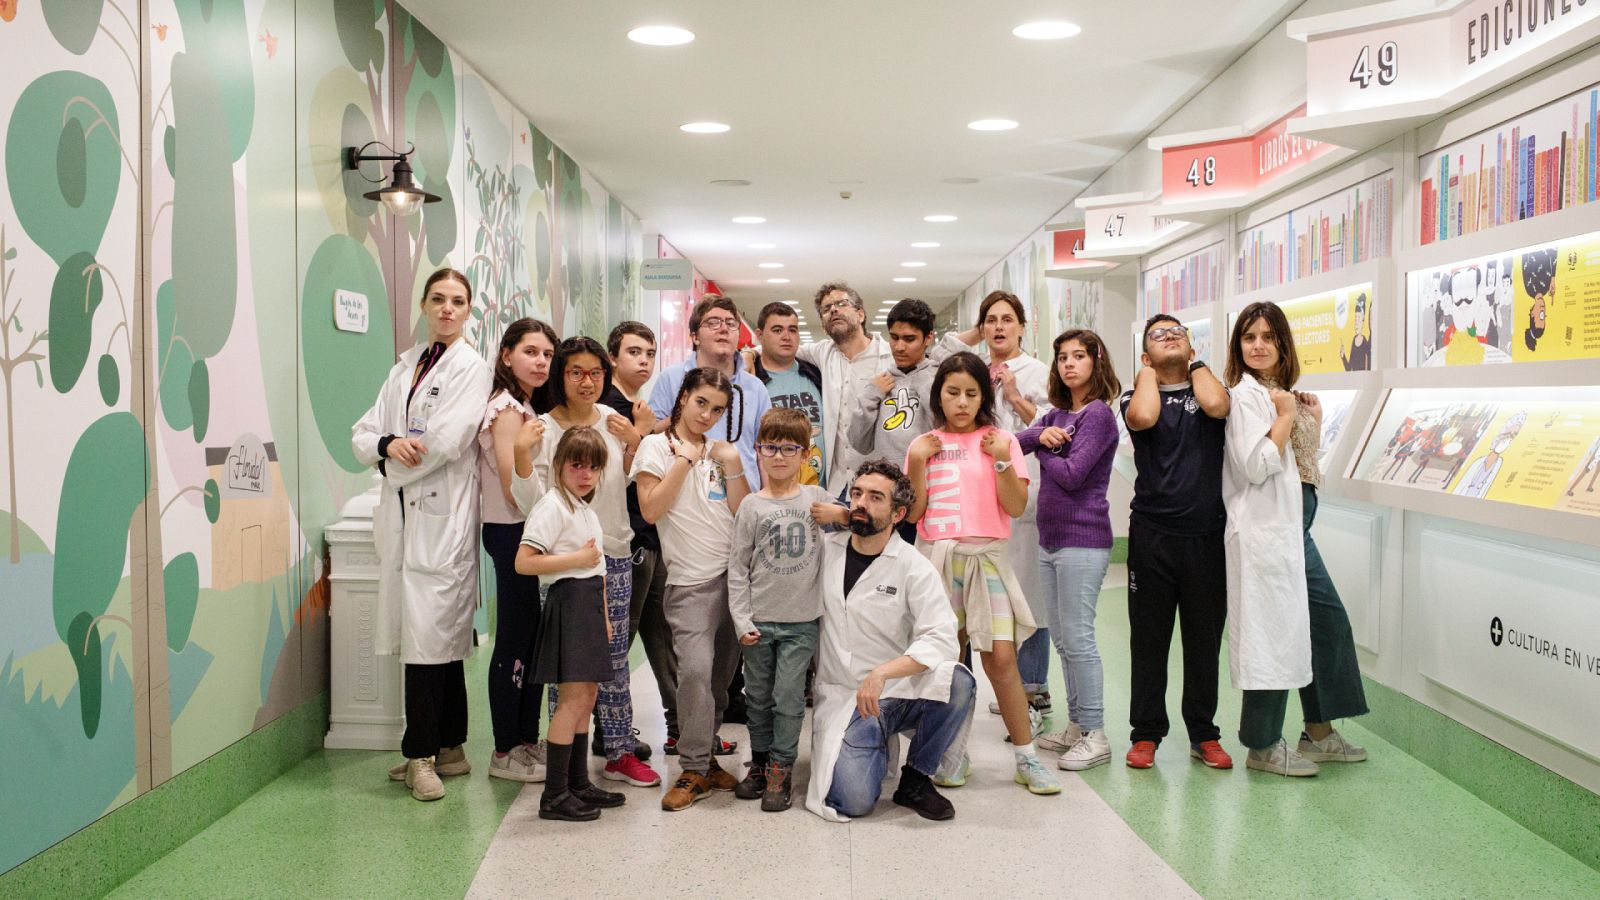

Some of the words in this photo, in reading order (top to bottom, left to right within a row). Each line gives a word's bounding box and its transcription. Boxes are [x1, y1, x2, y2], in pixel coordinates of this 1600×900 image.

[1468, 0, 1587, 65] EDICION
[1350, 41, 1399, 89] 49
[1186, 156, 1217, 186] 48
[1259, 131, 1289, 176] LIBROS
[1104, 214, 1126, 238] 47
[768, 522, 806, 559] 10
[1508, 628, 1559, 661] CULTURA
[1564, 647, 1581, 669] EN
